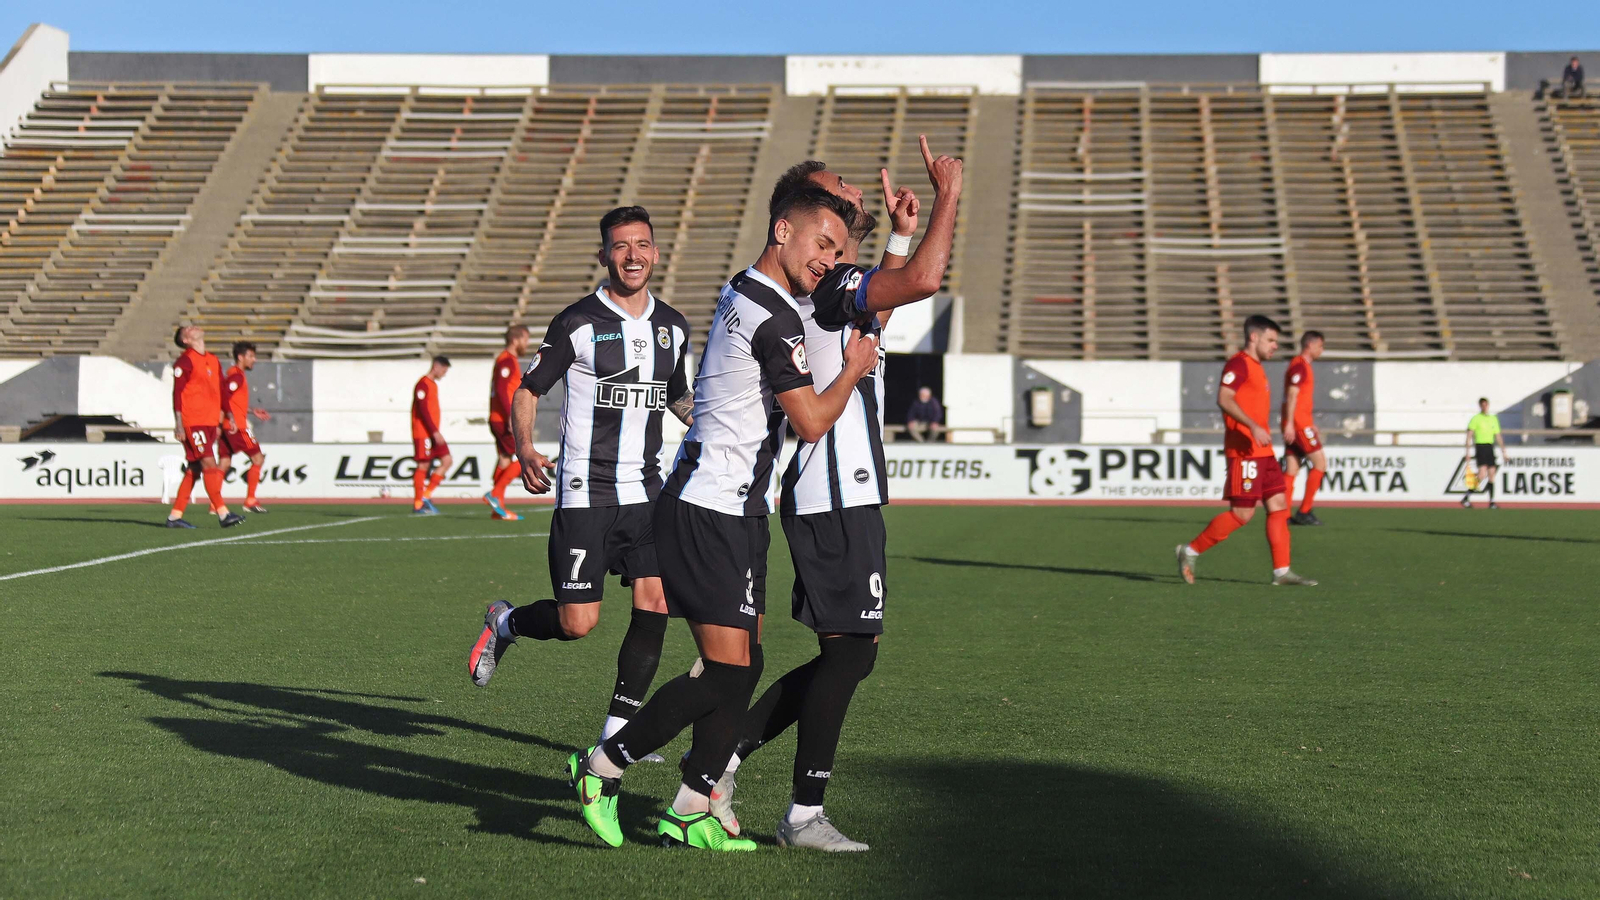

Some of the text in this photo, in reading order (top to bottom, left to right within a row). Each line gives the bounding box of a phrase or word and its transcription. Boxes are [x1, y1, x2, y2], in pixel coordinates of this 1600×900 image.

[591, 332, 622, 343] LEGEA
[594, 383, 667, 411] LOTUS
[192, 430, 207, 445] 21
[1099, 448, 1225, 480] PRIN
[1241, 460, 1258, 479] 16
[1328, 456, 1407, 469] INTURAS
[36, 460, 145, 494] aqualia
[1319, 471, 1409, 492] MATA
[1502, 472, 1575, 495] LACSE
[1101, 486, 1127, 497] THE
[1132, 486, 1184, 497] POWER
[1190, 486, 1208, 497] OF
[570, 548, 587, 581] 7
[562, 581, 592, 590] LEGEA
[869, 571, 883, 610] 9
